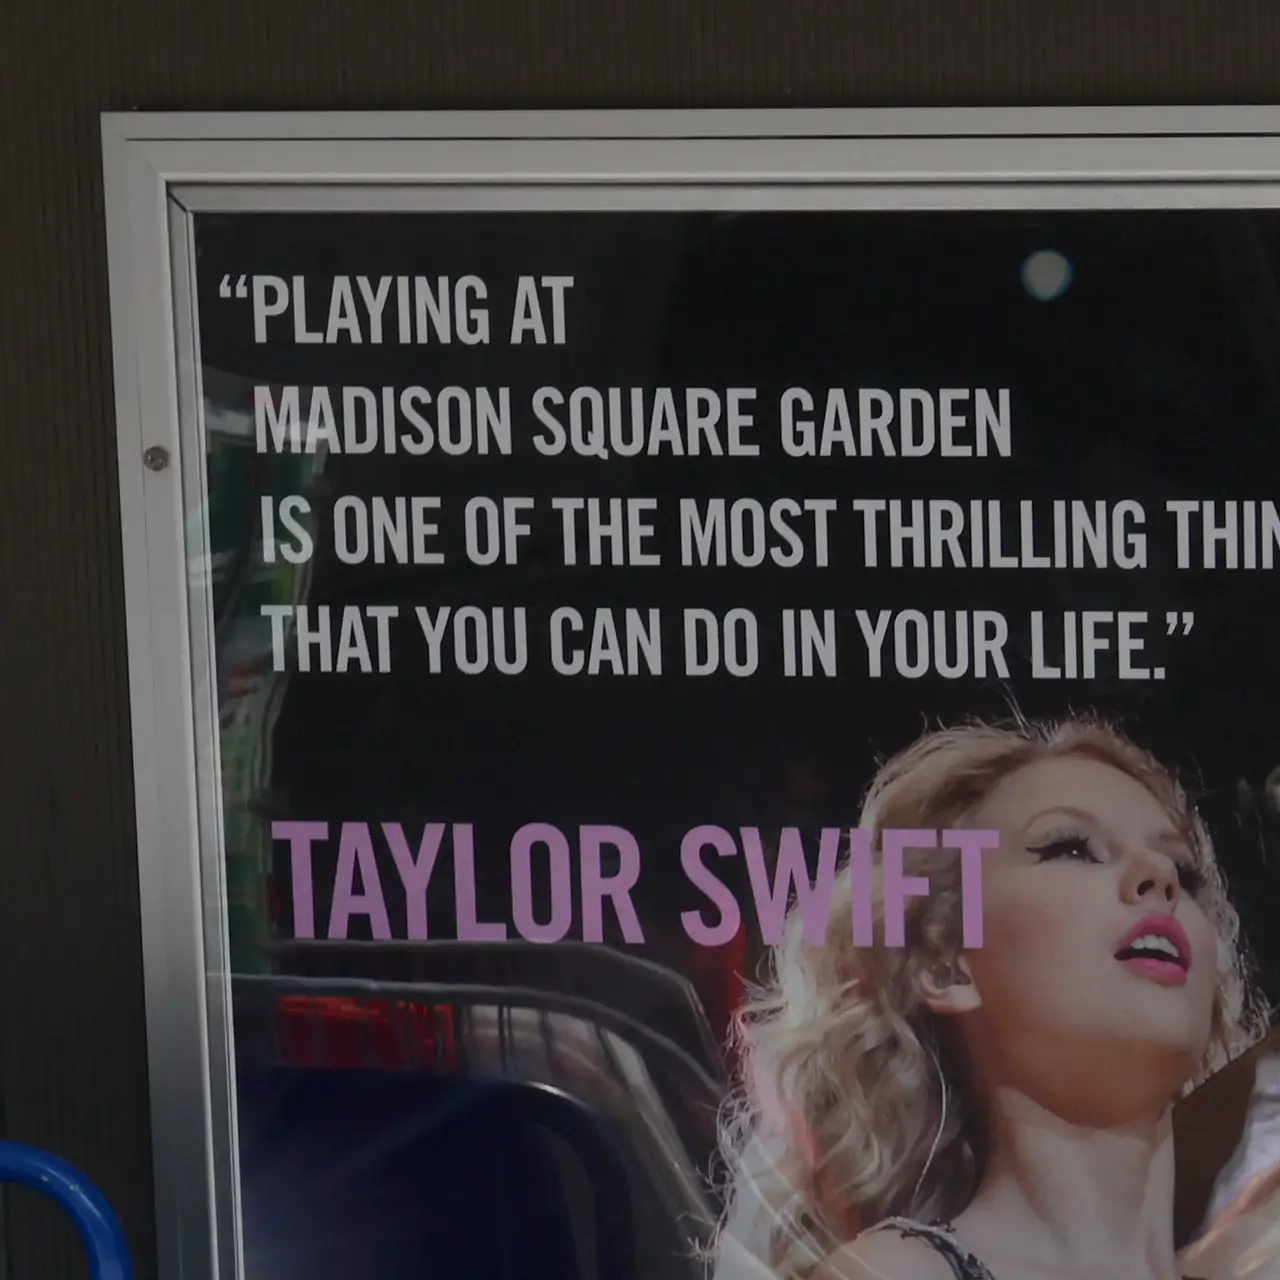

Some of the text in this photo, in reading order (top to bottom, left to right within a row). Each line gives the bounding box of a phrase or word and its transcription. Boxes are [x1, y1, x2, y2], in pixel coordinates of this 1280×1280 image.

[220, 275, 574, 344] “PLAYING AT
[255, 386, 1012, 460] MADISON SQUARE GARDEN
[261, 496, 314, 564] IS
[333, 496, 444, 564] ONE
[465, 497, 533, 564] OF
[551, 498, 660, 566] THE
[679, 499, 836, 567] MOST
[853, 500, 1147, 569] THRILLING
[261, 605, 1194, 680] THAT YOU CAN DO IN YOUR LIFE.”
[271, 821, 1000, 949] TAYLOR SWIFT
